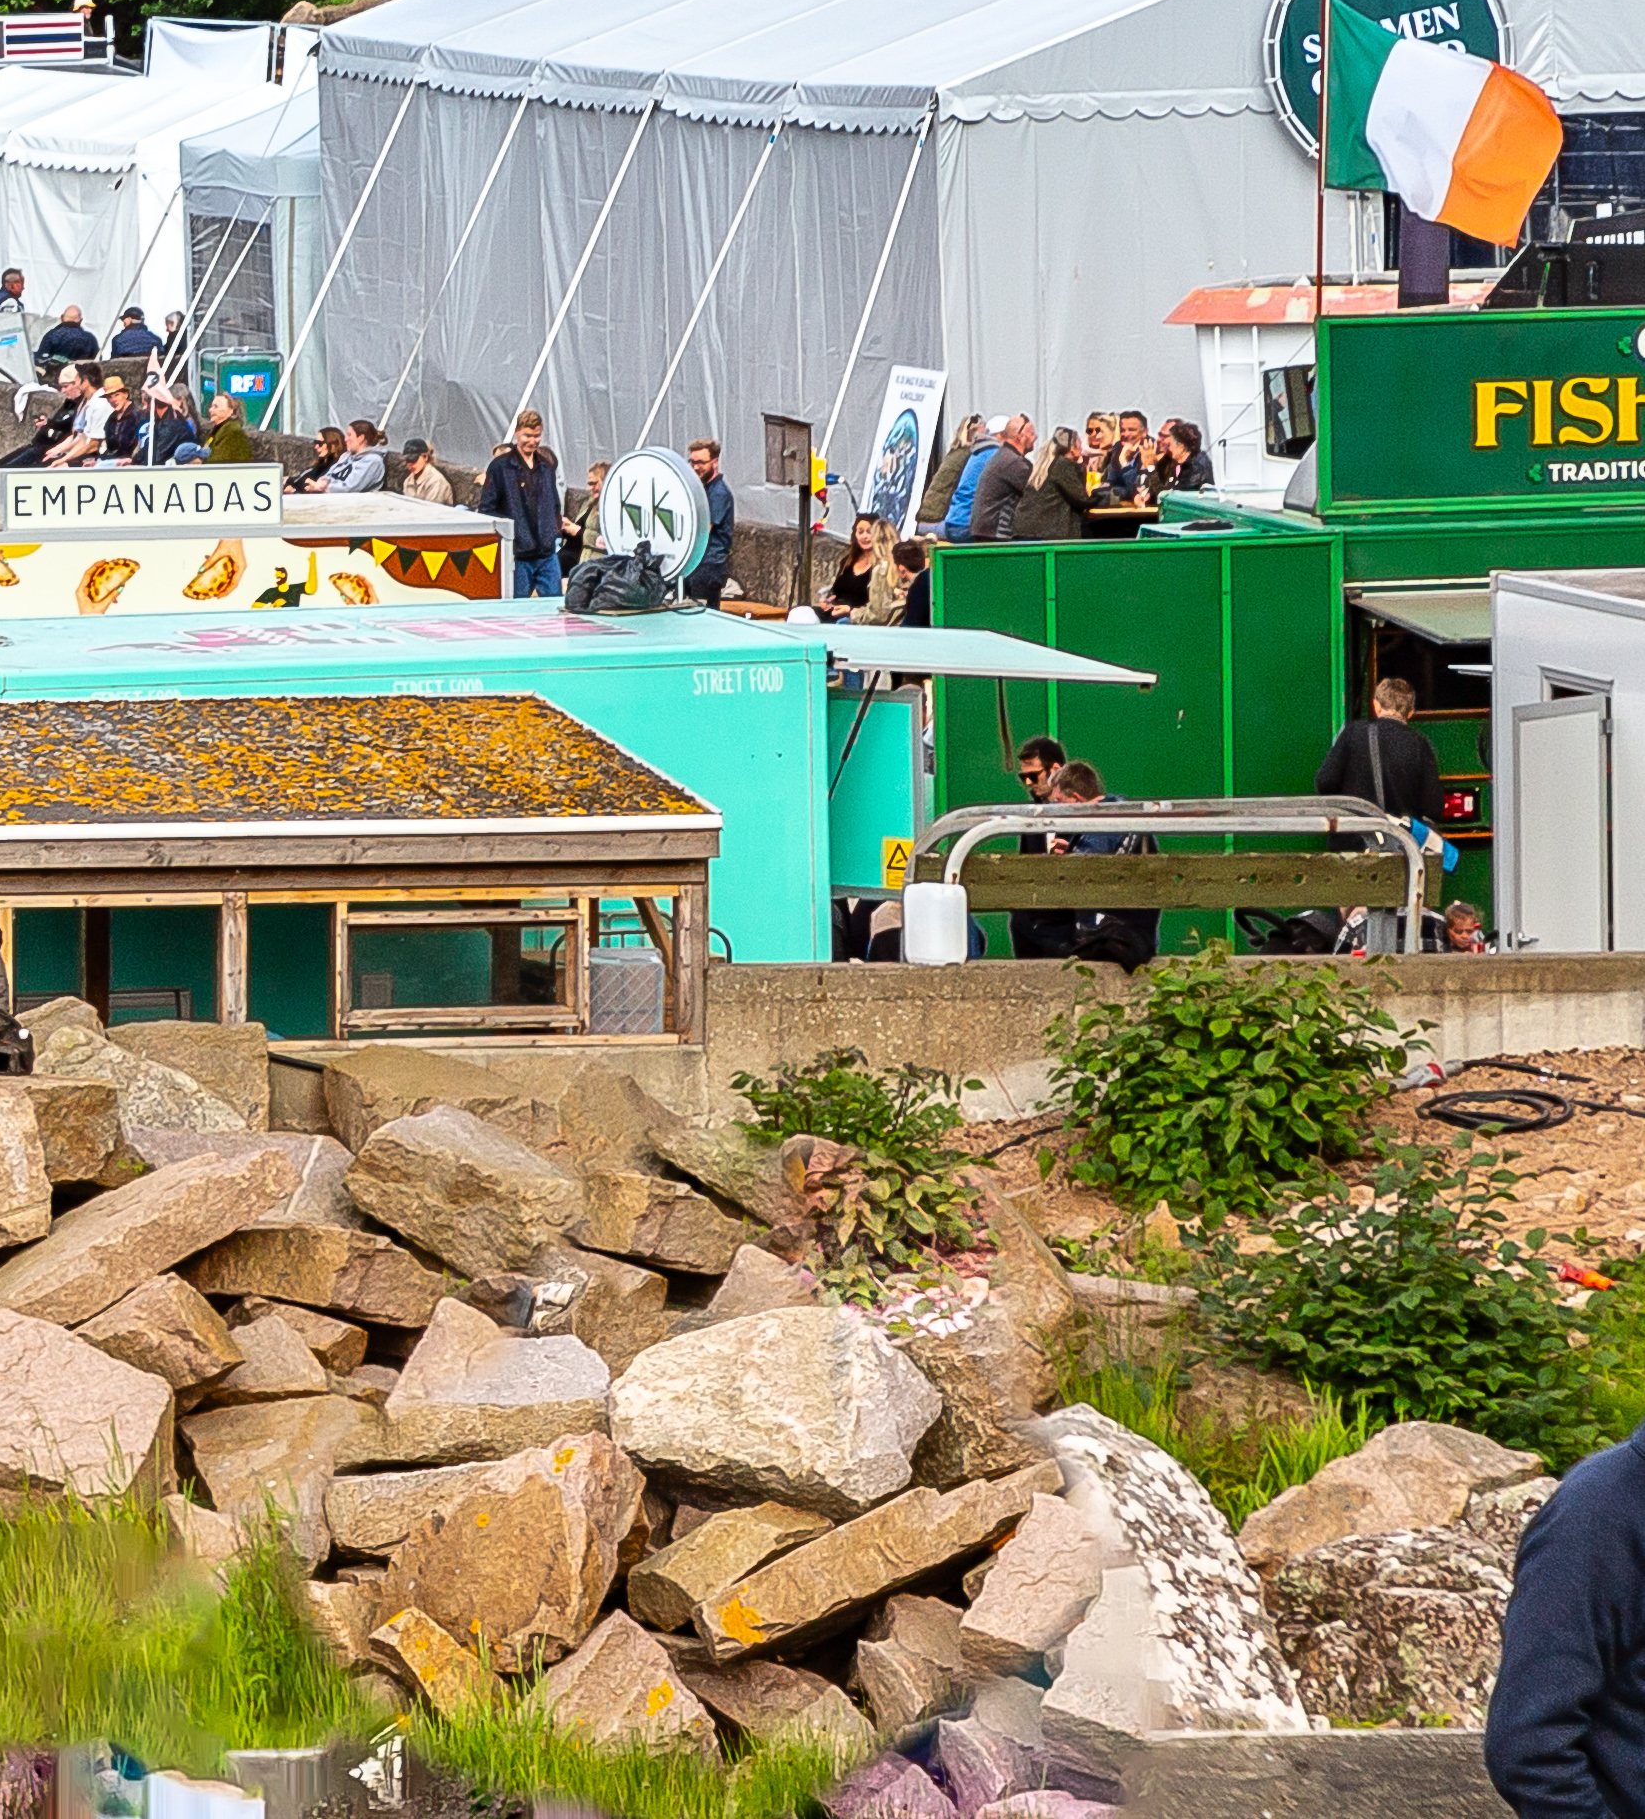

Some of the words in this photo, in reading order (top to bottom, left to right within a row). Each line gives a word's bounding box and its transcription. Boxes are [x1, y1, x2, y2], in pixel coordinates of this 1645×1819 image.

[14, 480, 273, 517] EMPANADAS
[692, 667, 745, 696] STREET
[748, 666, 784, 693] FOOD
